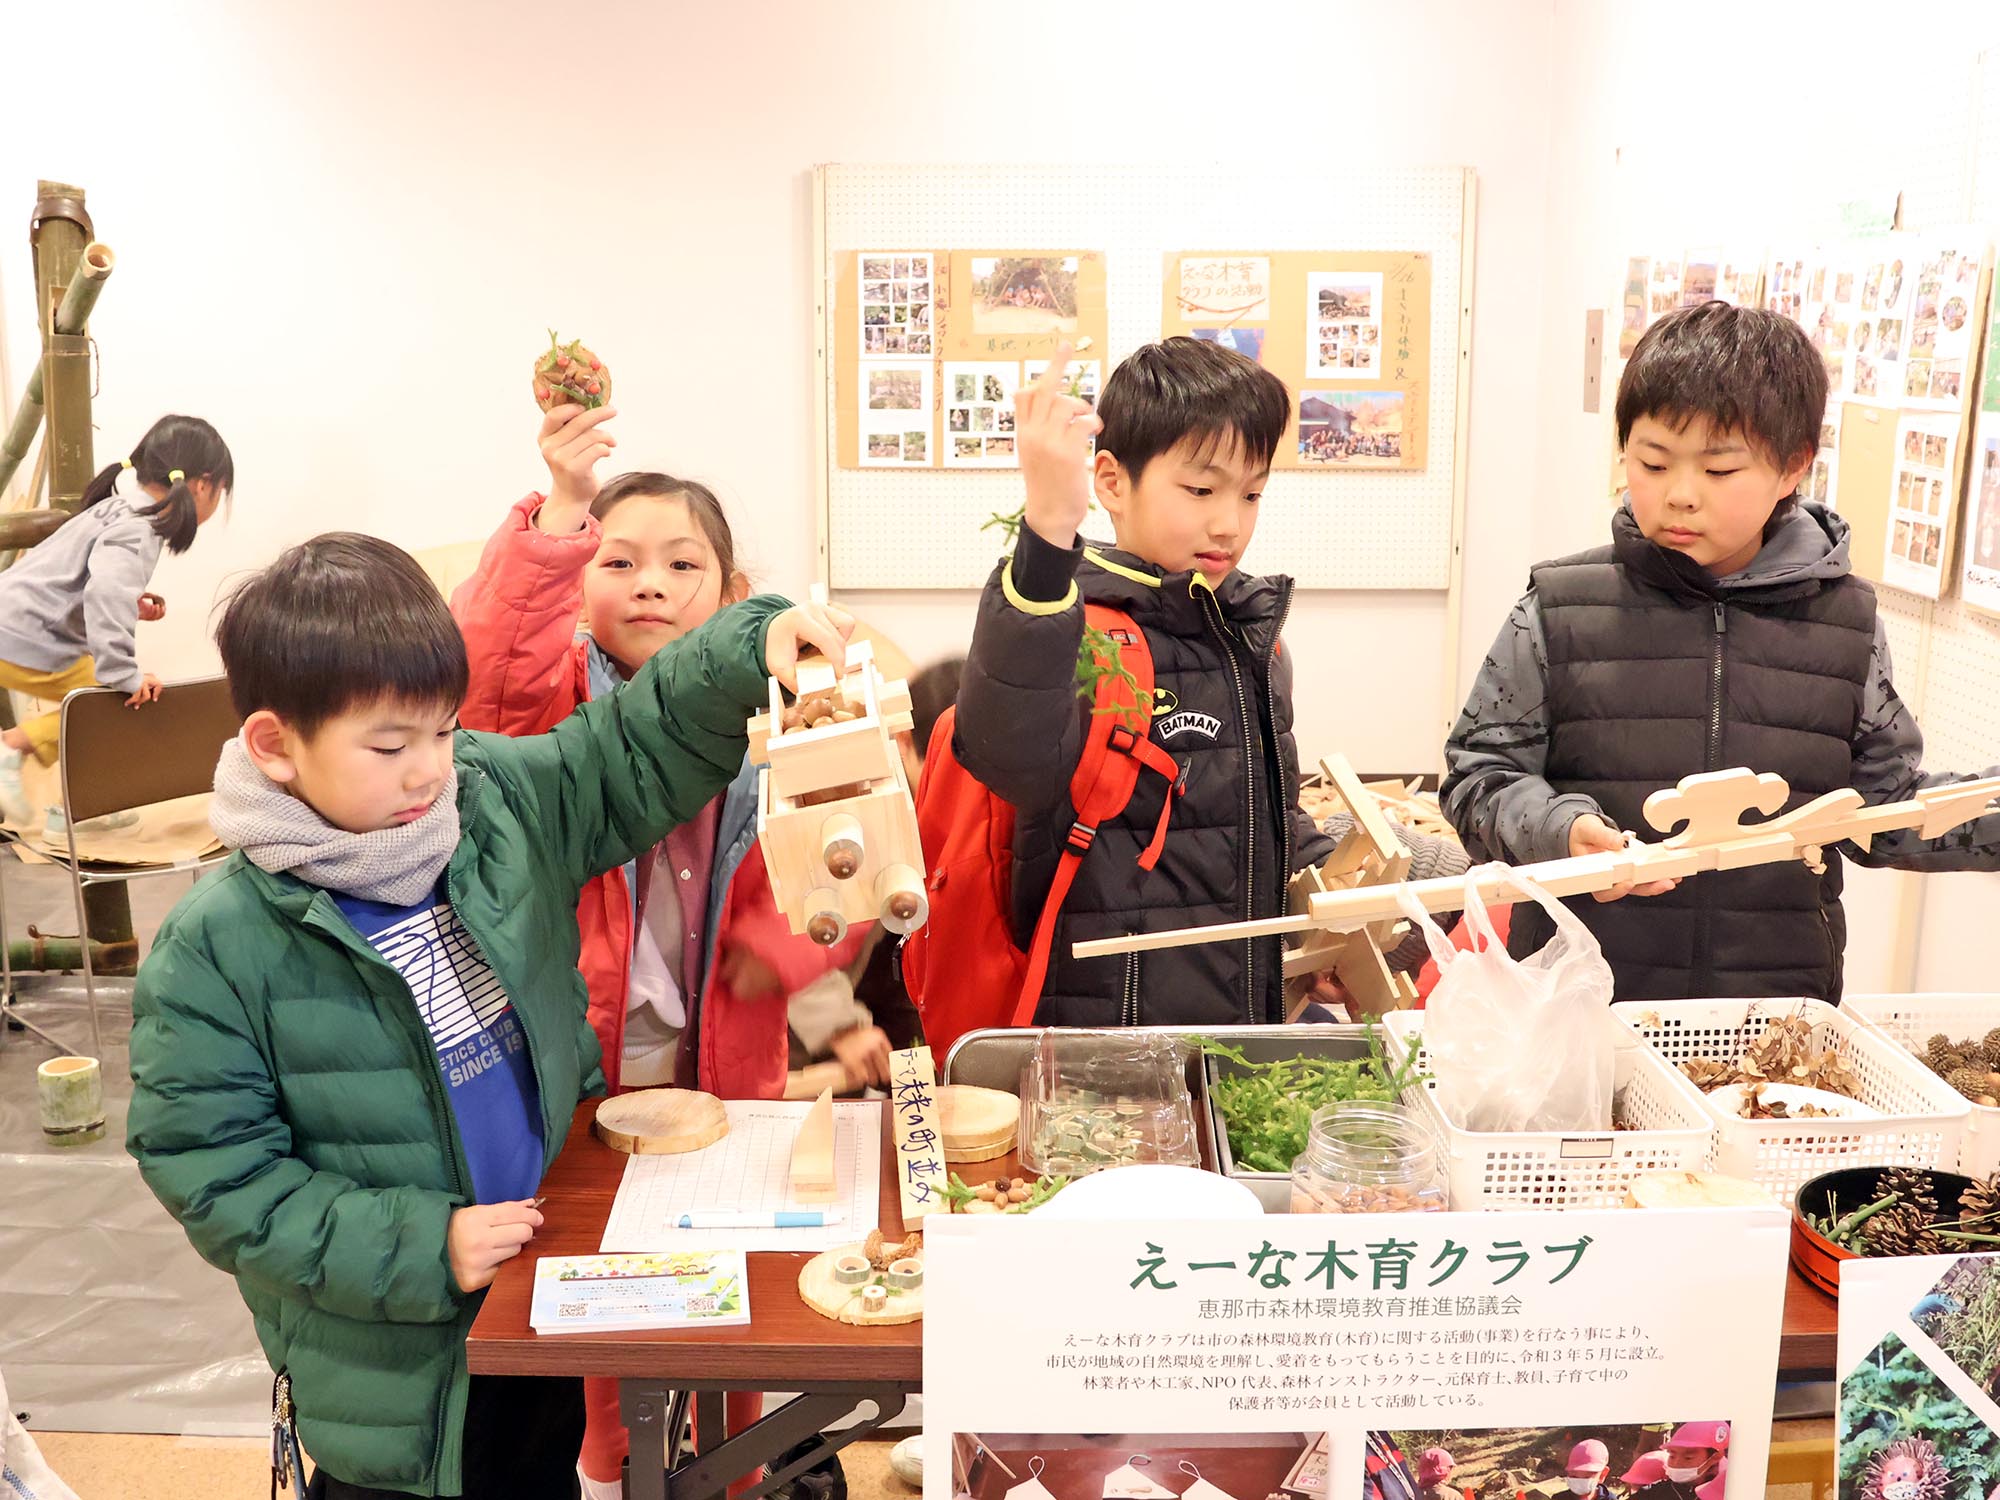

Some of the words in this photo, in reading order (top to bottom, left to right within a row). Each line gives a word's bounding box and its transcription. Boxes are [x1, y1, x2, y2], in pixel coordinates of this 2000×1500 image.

[1160, 714, 1218, 735] BATMAN
[478, 1018, 515, 1048] CLUB
[449, 1044, 503, 1088] SINCE
[1129, 1234, 1595, 1291] えーな木育クラブ
[1198, 1295, 1523, 1319] 恵那市森林環境教育推進協議会
[1228, 1393, 1485, 1411] 保護者等が会員として活動している。
